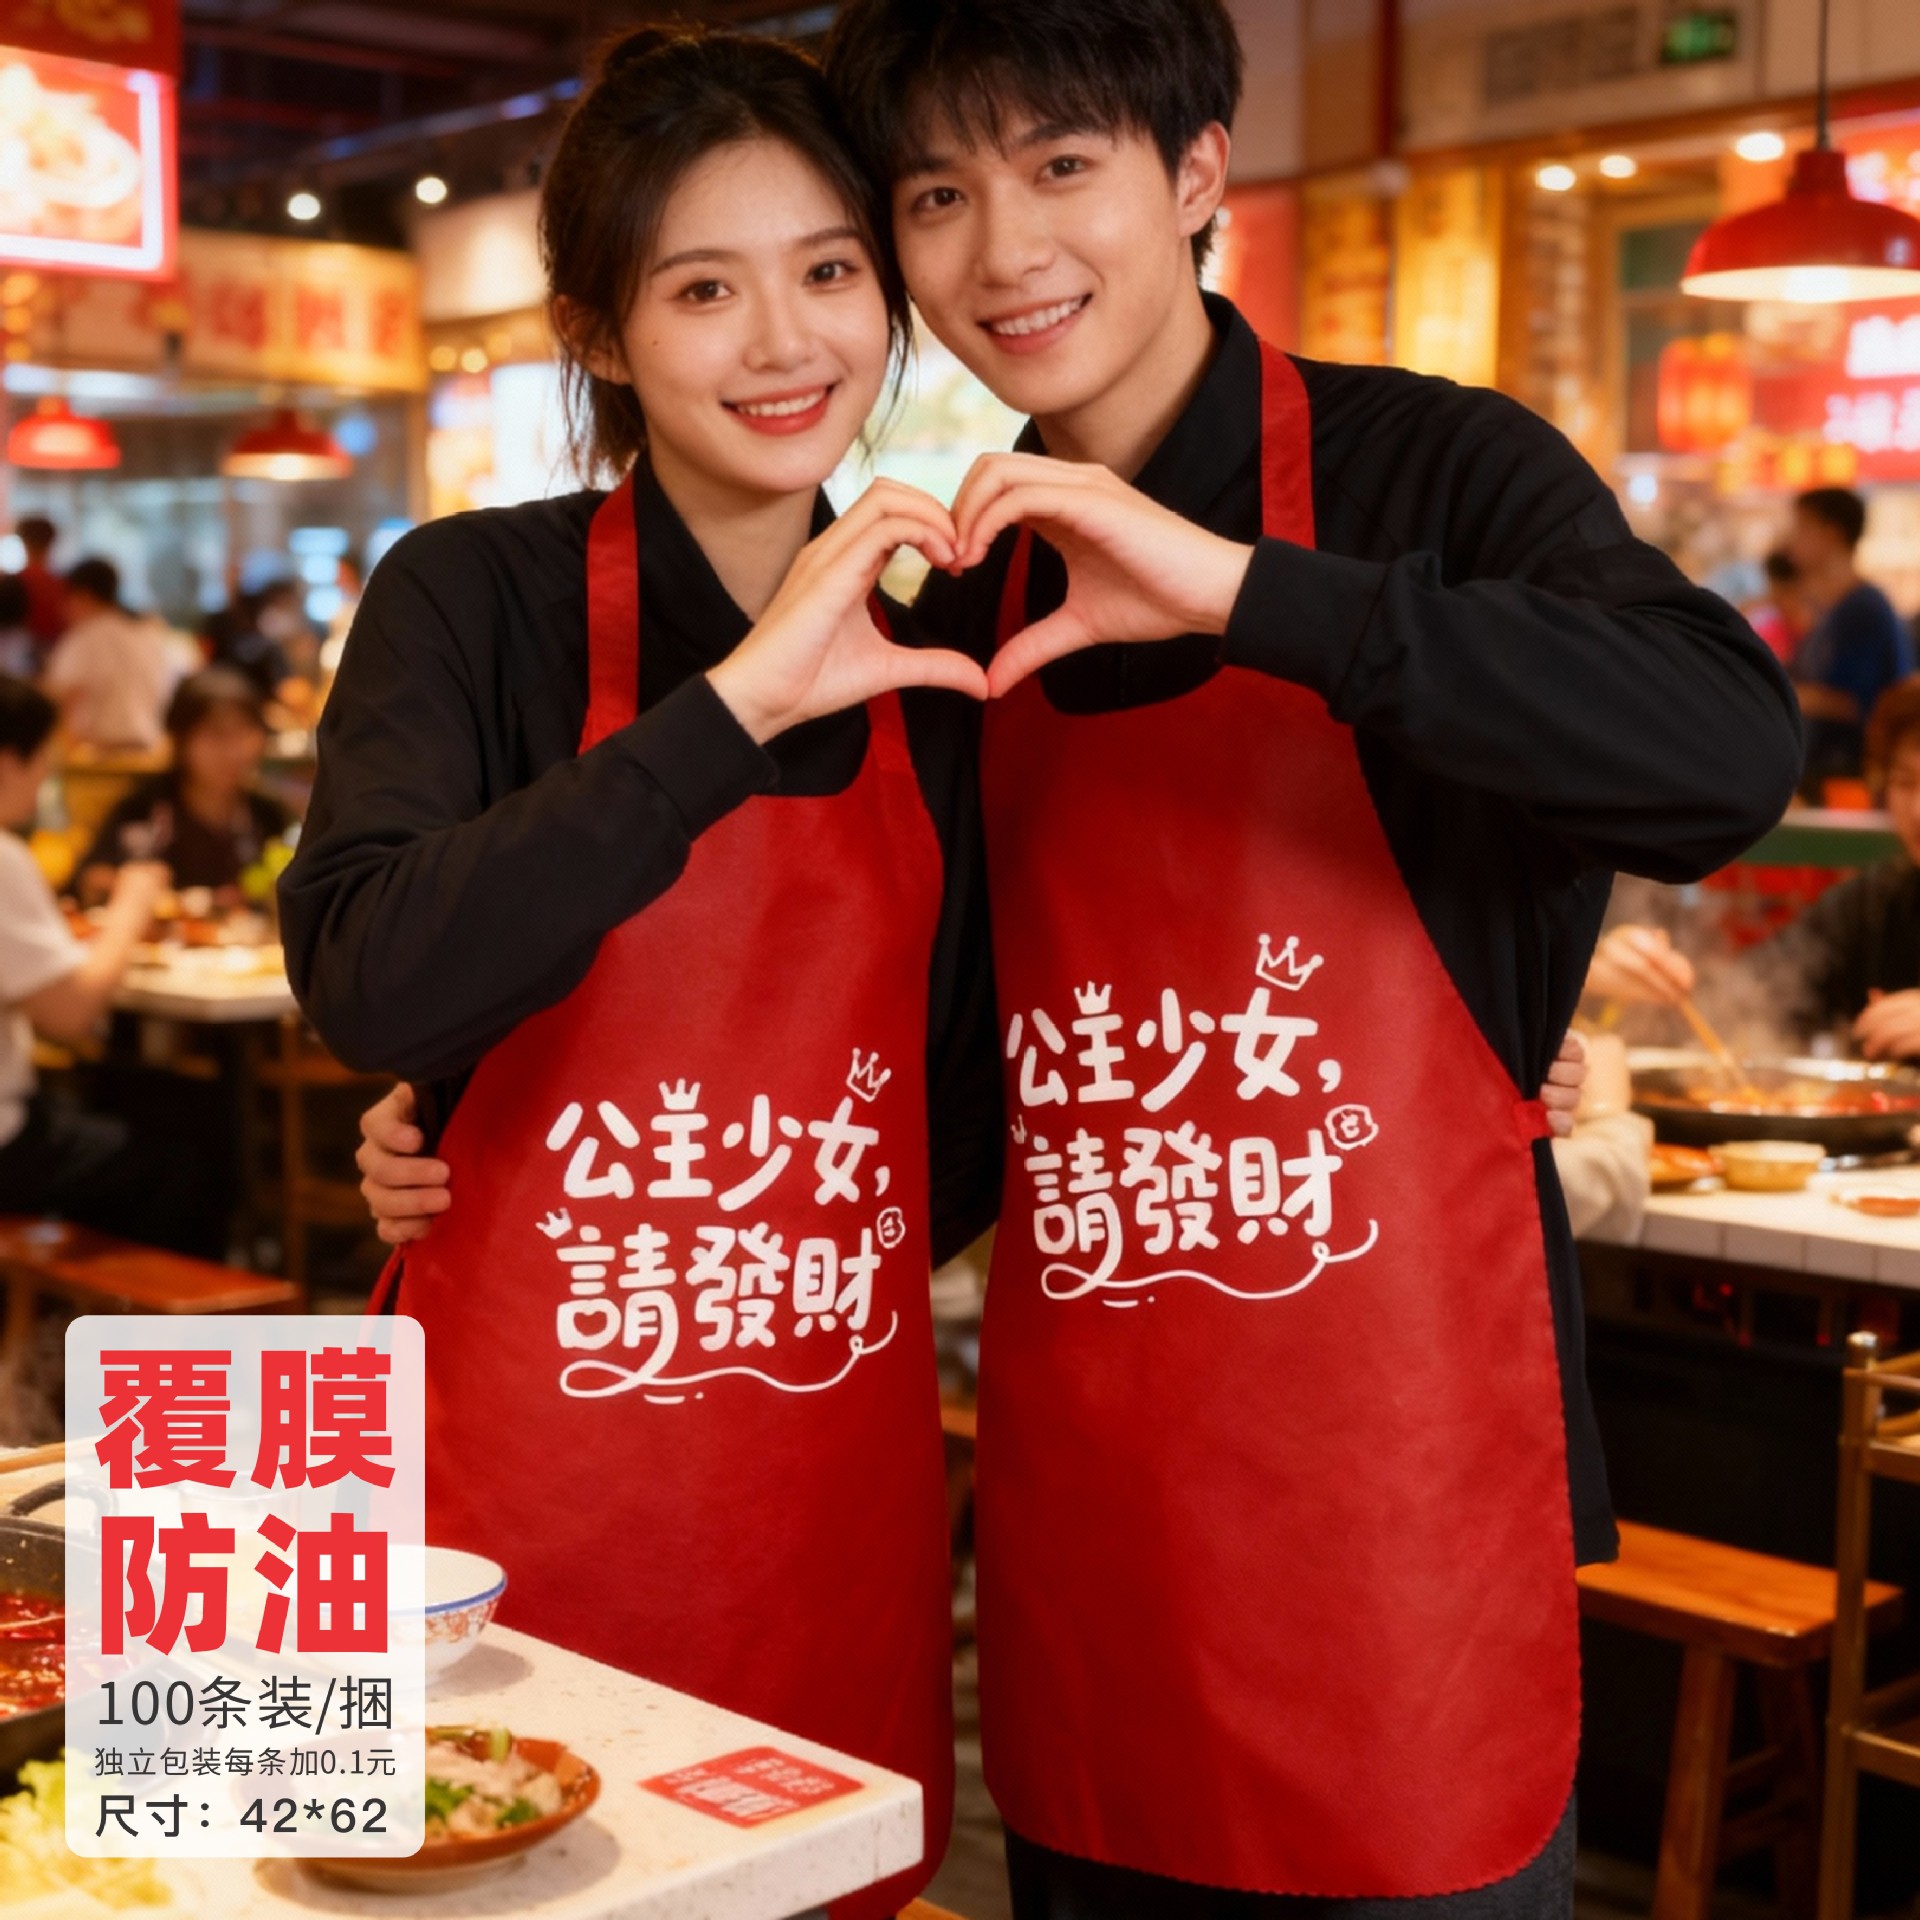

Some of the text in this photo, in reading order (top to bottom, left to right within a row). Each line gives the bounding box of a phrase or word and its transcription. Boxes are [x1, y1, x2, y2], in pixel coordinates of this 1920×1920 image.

[1025, 1121, 1343, 1258] 請發財
[556, 1223, 882, 1353] 請發財
